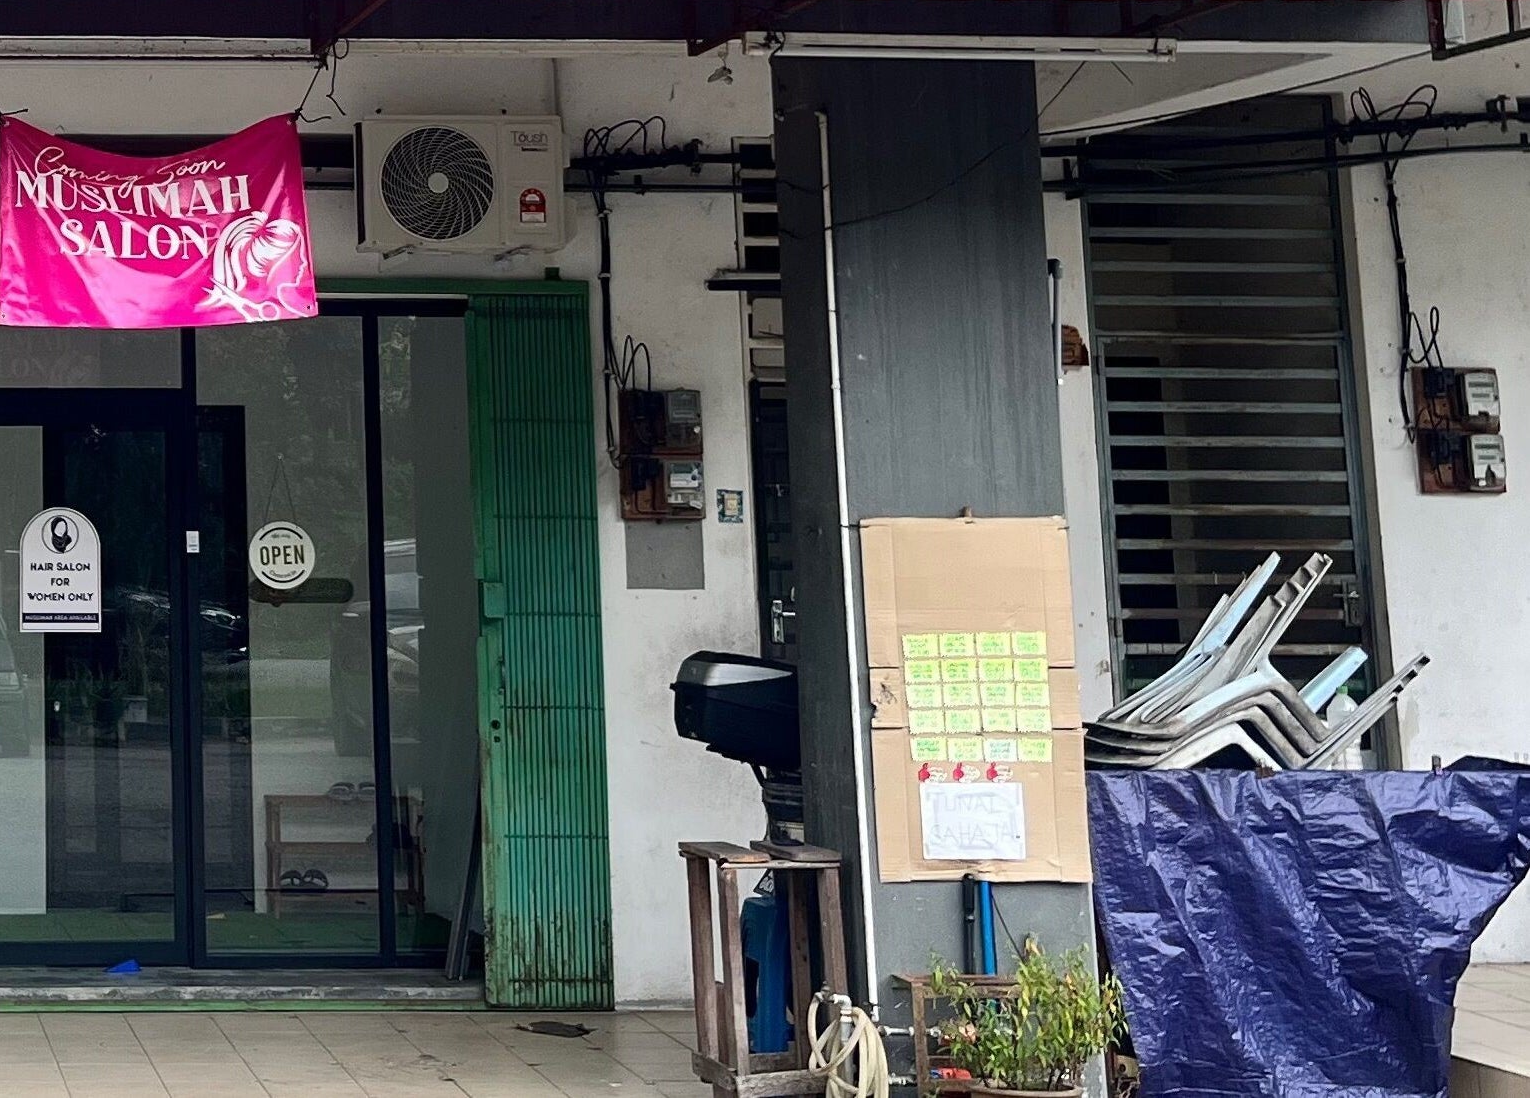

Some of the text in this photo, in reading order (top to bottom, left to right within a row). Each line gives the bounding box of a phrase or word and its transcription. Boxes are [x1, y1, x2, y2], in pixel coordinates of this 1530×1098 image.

[35, 146, 226, 198] Coming Soon
[15, 170, 252, 219] MUSLIMAH
[59, 219, 211, 260] SALON
[260, 545, 305, 566] OPEN
[30, 562, 91, 571] HAIR SALON
[50, 577, 70, 586] FOR
[27, 592, 94, 601] WOMEN ONLY
